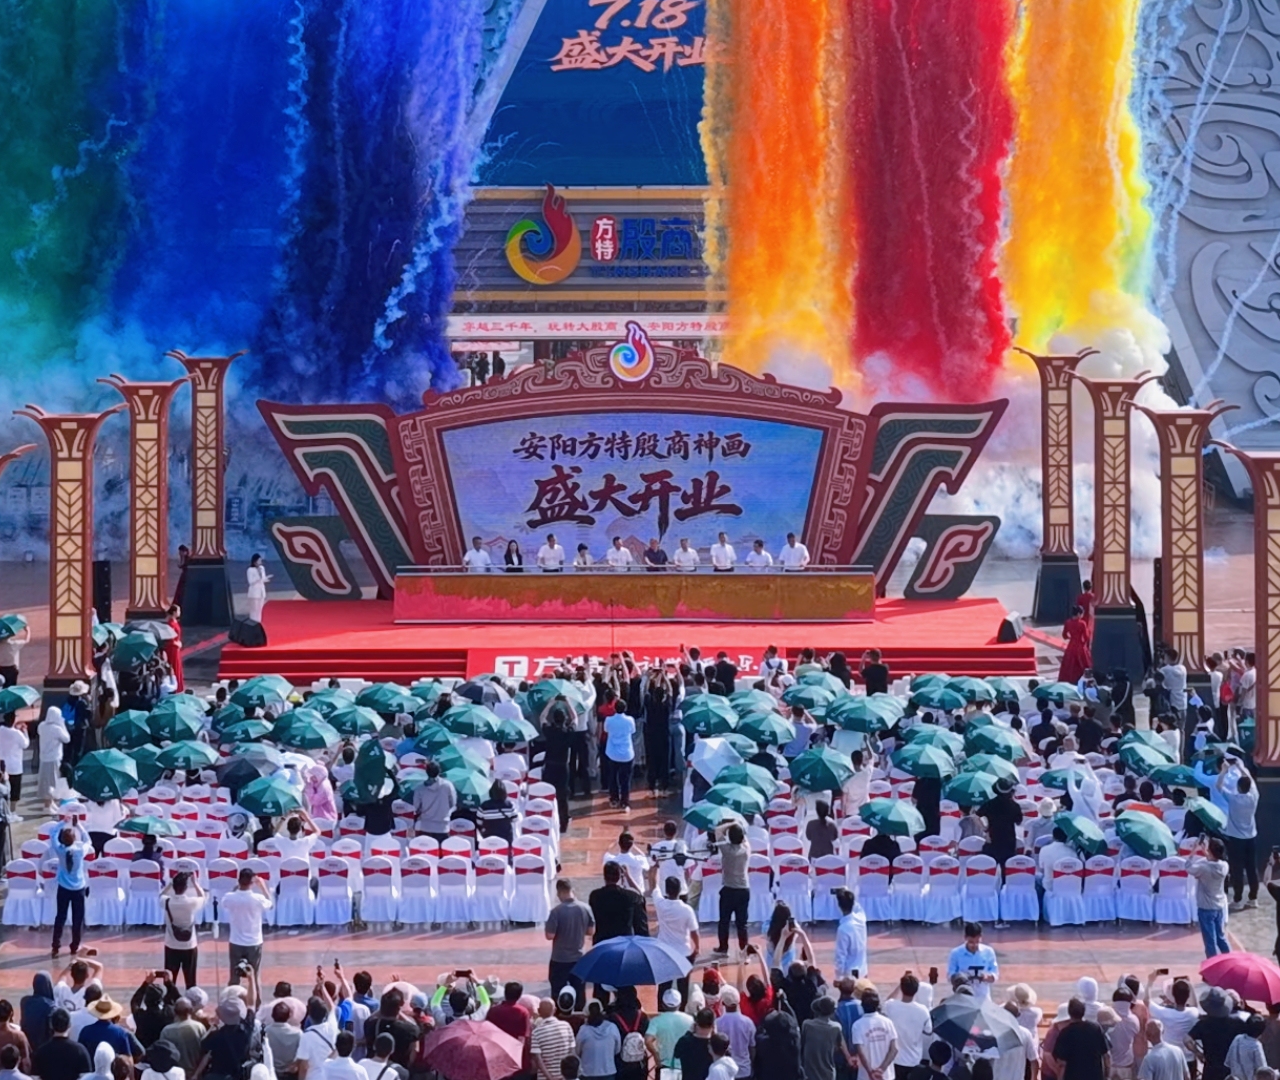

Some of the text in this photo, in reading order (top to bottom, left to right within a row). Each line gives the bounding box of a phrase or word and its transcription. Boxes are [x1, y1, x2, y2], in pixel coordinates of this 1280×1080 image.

[596, 218, 614, 260] 方特
[621, 217, 704, 260] 殷商
[513, 430, 751, 464] 安阳方特殷商神画
[524, 464, 743, 543] 盛大开业
